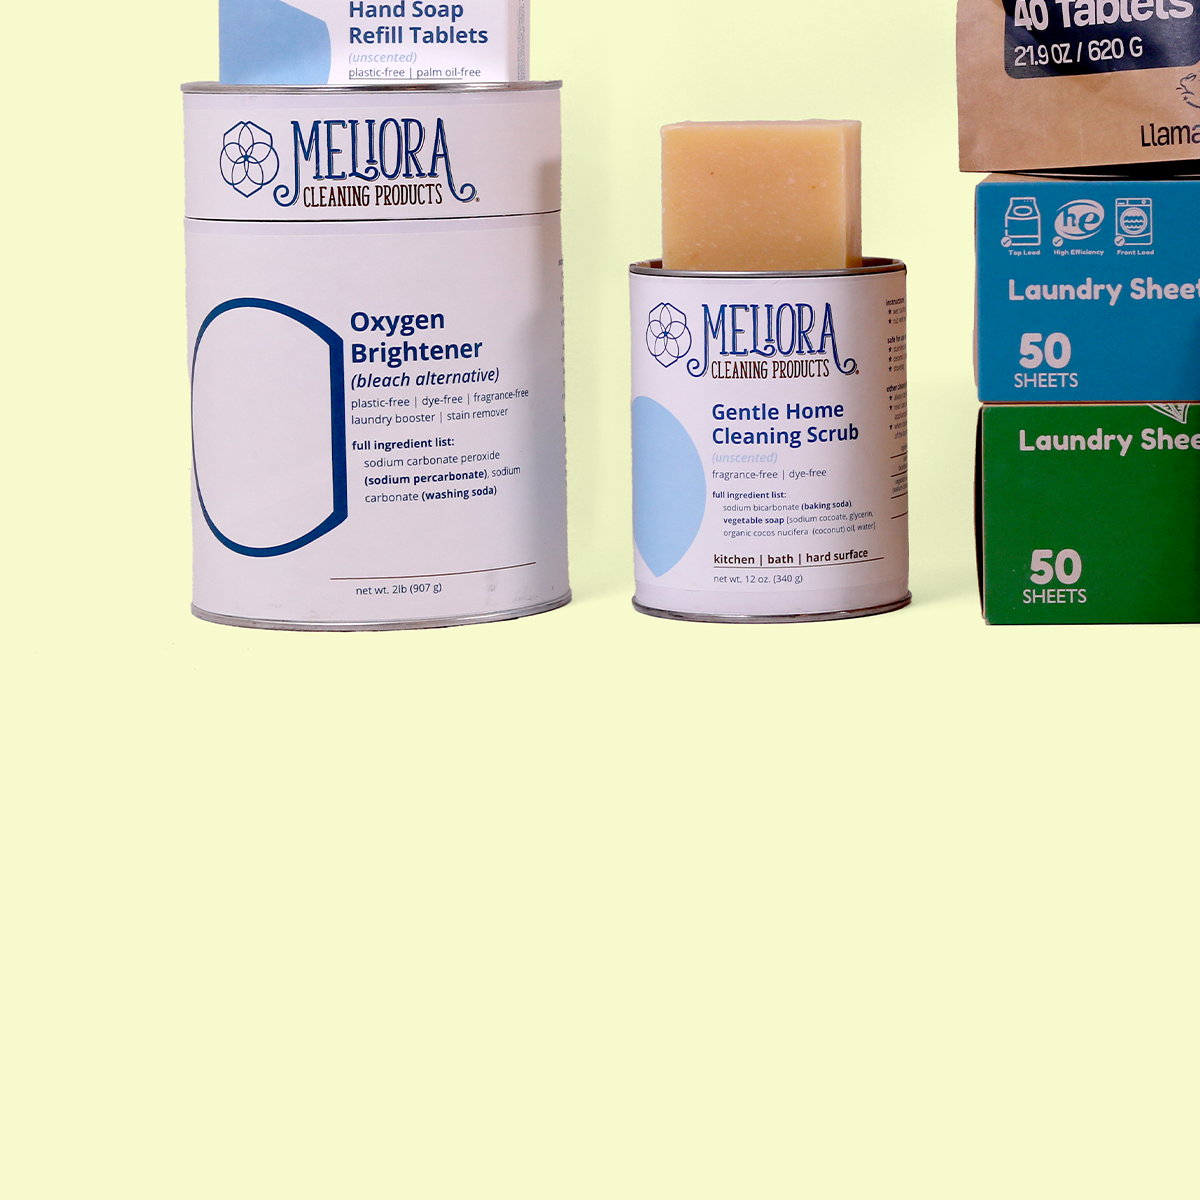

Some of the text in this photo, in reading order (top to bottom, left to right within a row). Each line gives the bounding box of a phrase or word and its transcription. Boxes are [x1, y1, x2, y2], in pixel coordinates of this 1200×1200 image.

[349, 0, 464, 22] Hand Soap
[349, 26, 489, 44] Refill Tablets
[348, 51, 418, 65] (unscented)
[1014, 36, 1143, 67] 21.9 OZ 620 G
[349, 67, 481, 79] plastic-free palm oil-free
[273, 118, 477, 208] MELIORA
[303, 182, 443, 208] CLEANING PRODUCTS
[1008, 277, 1123, 307] Laundry
[350, 311, 445, 337] Oxygen
[686, 302, 857, 377] MELIORA
[351, 339, 483, 368] Brightener
[1019, 332, 1072, 369] 50
[351, 367, 500, 390] (bleach alternative)
[711, 359, 830, 379] CLEANING PRODUCTS
[1014, 372, 1079, 388] SHEETS
[351, 388, 529, 410] plastic-free dye-free fragrance-free
[351, 406, 508, 427] laundry booster stain remover
[712, 402, 844, 422] Gentle Home
[351, 436, 455, 452] full ingredient list:
[712, 423, 859, 448] Cleaning Scrub
[1019, 427, 1133, 457] Laundry
[364, 450, 500, 468] sodium carbonate peroxide
[712, 452, 778, 464] (unscented)
[364, 473, 410, 487] (sodium
[491, 465, 521, 478] sodium
[712, 468, 827, 481] fragrance-free dye-free
[365, 485, 497, 503] carbonate (washing soda)
[726, 491, 769, 501] ingredient
[723, 503, 799, 512] sodium bicarbonate
[723, 516, 785, 526] vegetable soap
[713, 549, 869, 565] kitchen bath hard surface
[1030, 549, 1082, 585] 50
[356, 585, 372, 595] net
[1022, 589, 1087, 604] SHEETS
